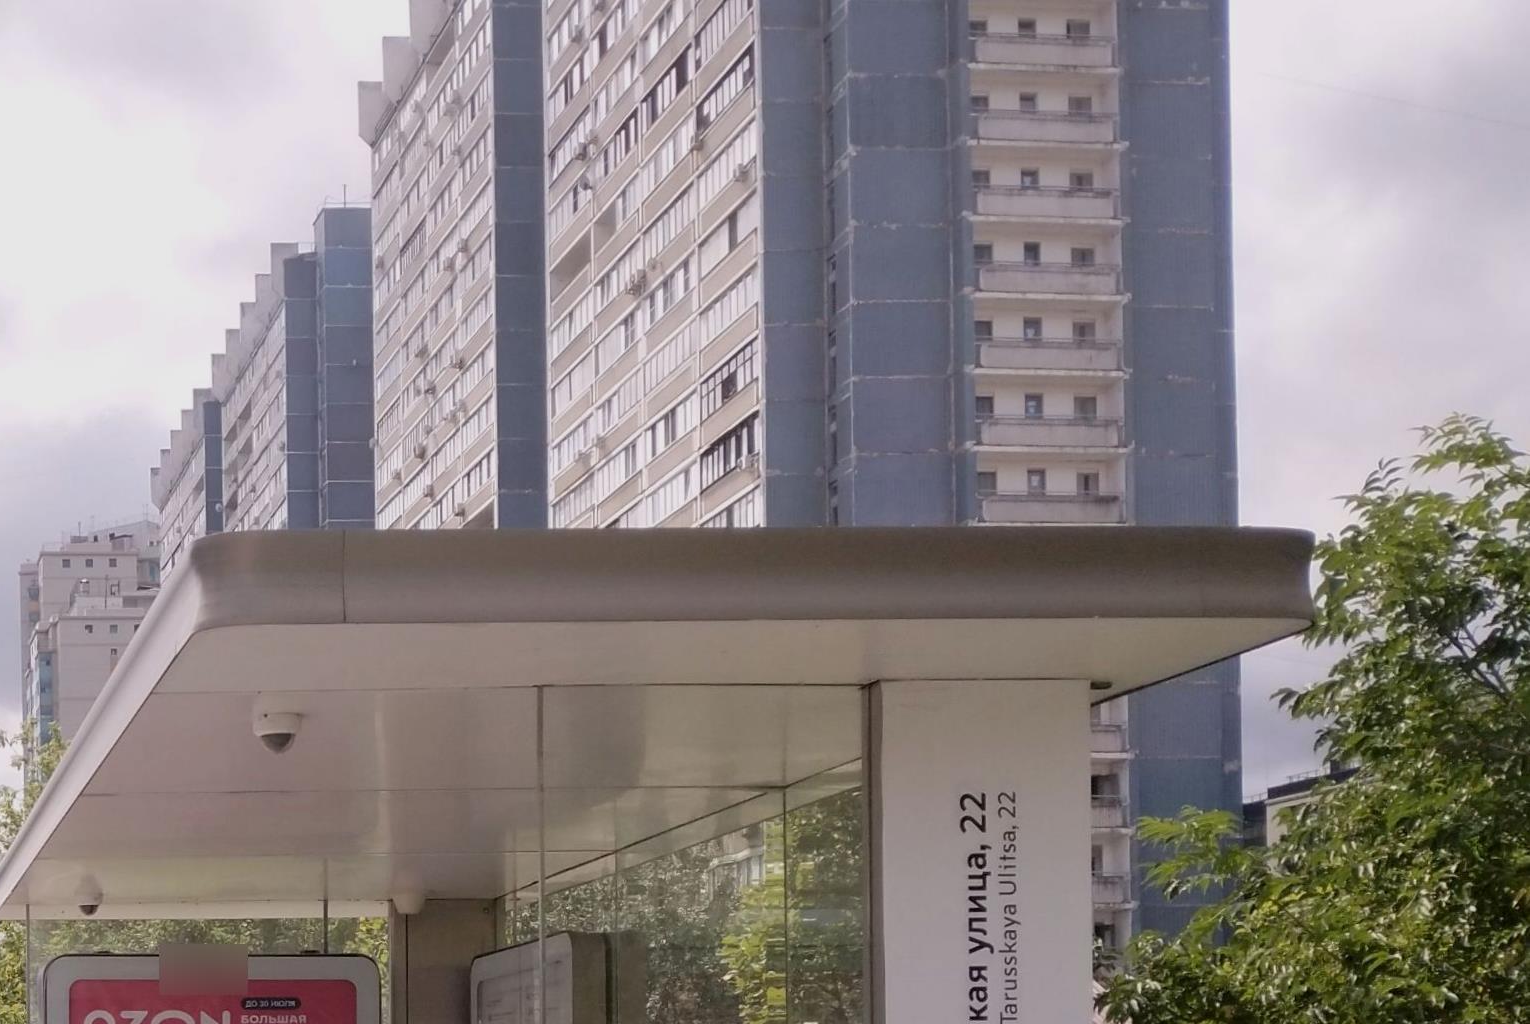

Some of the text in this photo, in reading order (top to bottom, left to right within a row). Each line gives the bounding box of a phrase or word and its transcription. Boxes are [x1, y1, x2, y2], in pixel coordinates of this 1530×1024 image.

[960, 792, 987, 833] 22
[998, 791, 1017, 819] 22
[998, 825, 1019, 896] Ulitsa,
[967, 842, 994, 954] улица,
[240, 1014, 307, 1024] БОЛЬШАЯ
